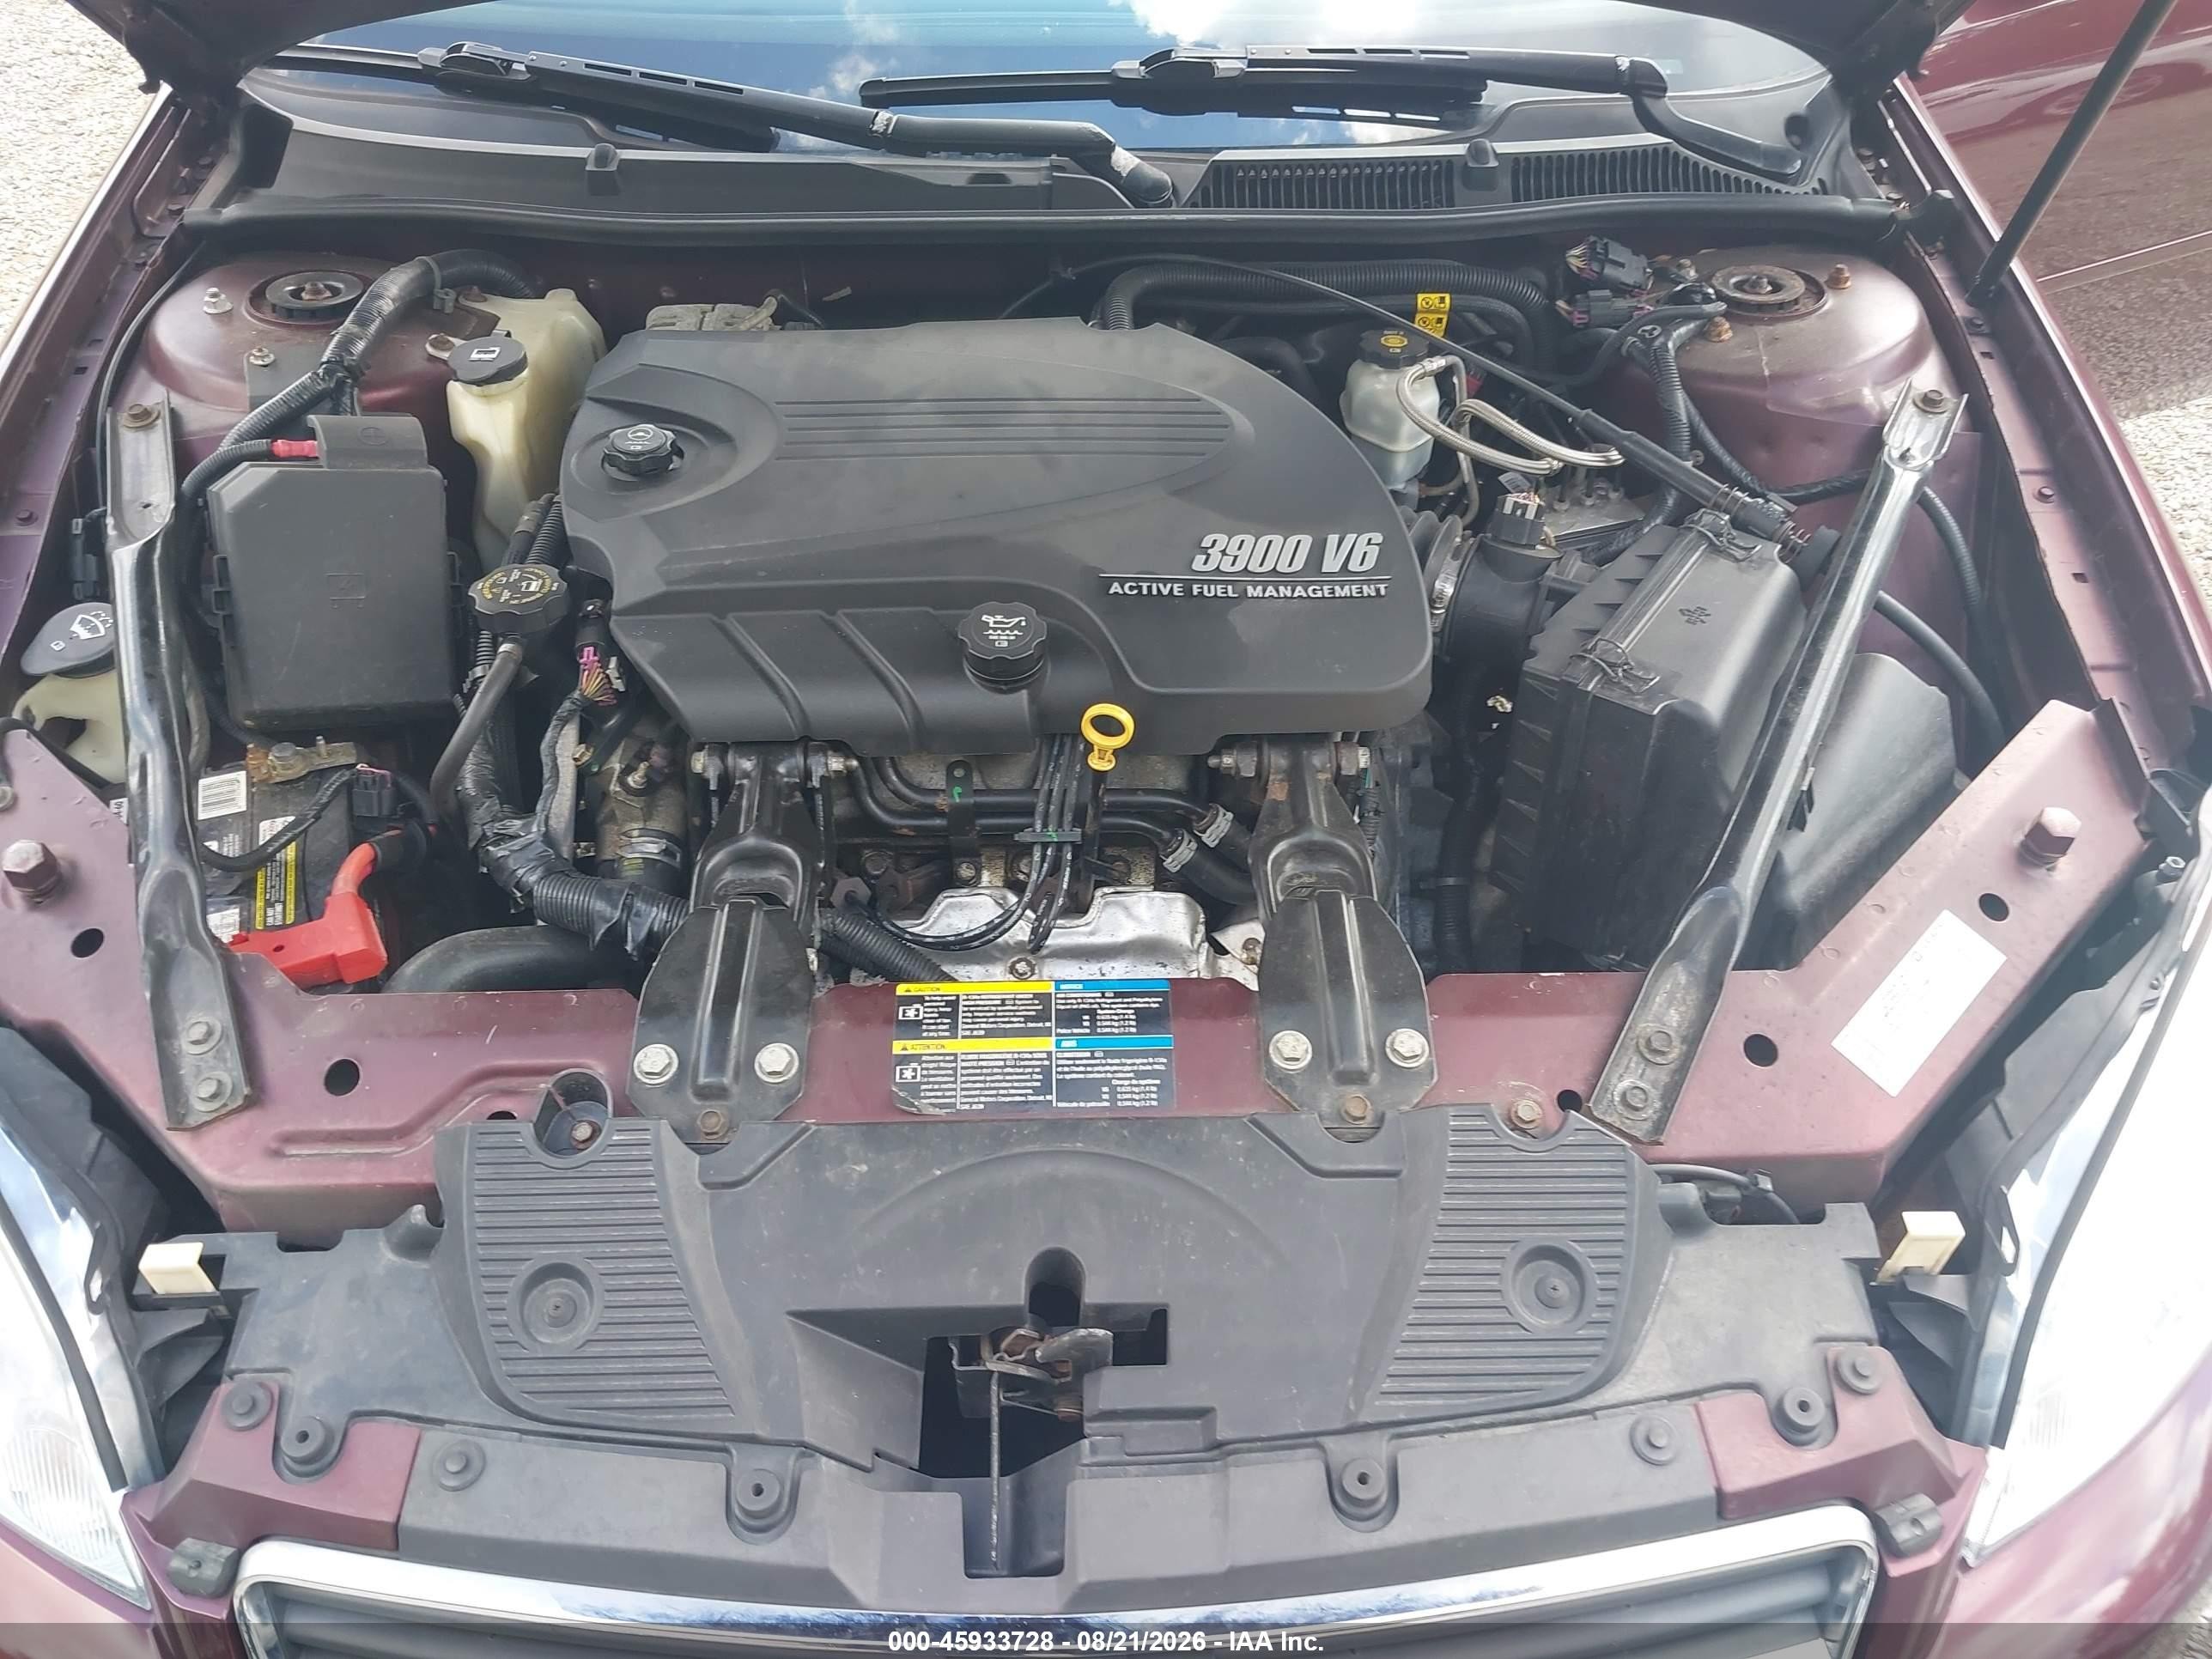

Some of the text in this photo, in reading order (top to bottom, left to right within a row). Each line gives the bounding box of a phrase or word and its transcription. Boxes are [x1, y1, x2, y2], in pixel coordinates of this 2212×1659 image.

[1191, 532, 1384, 574] 3900 V6
[1109, 581, 1389, 599] ACTIVE FUEL MANAGEMENT
